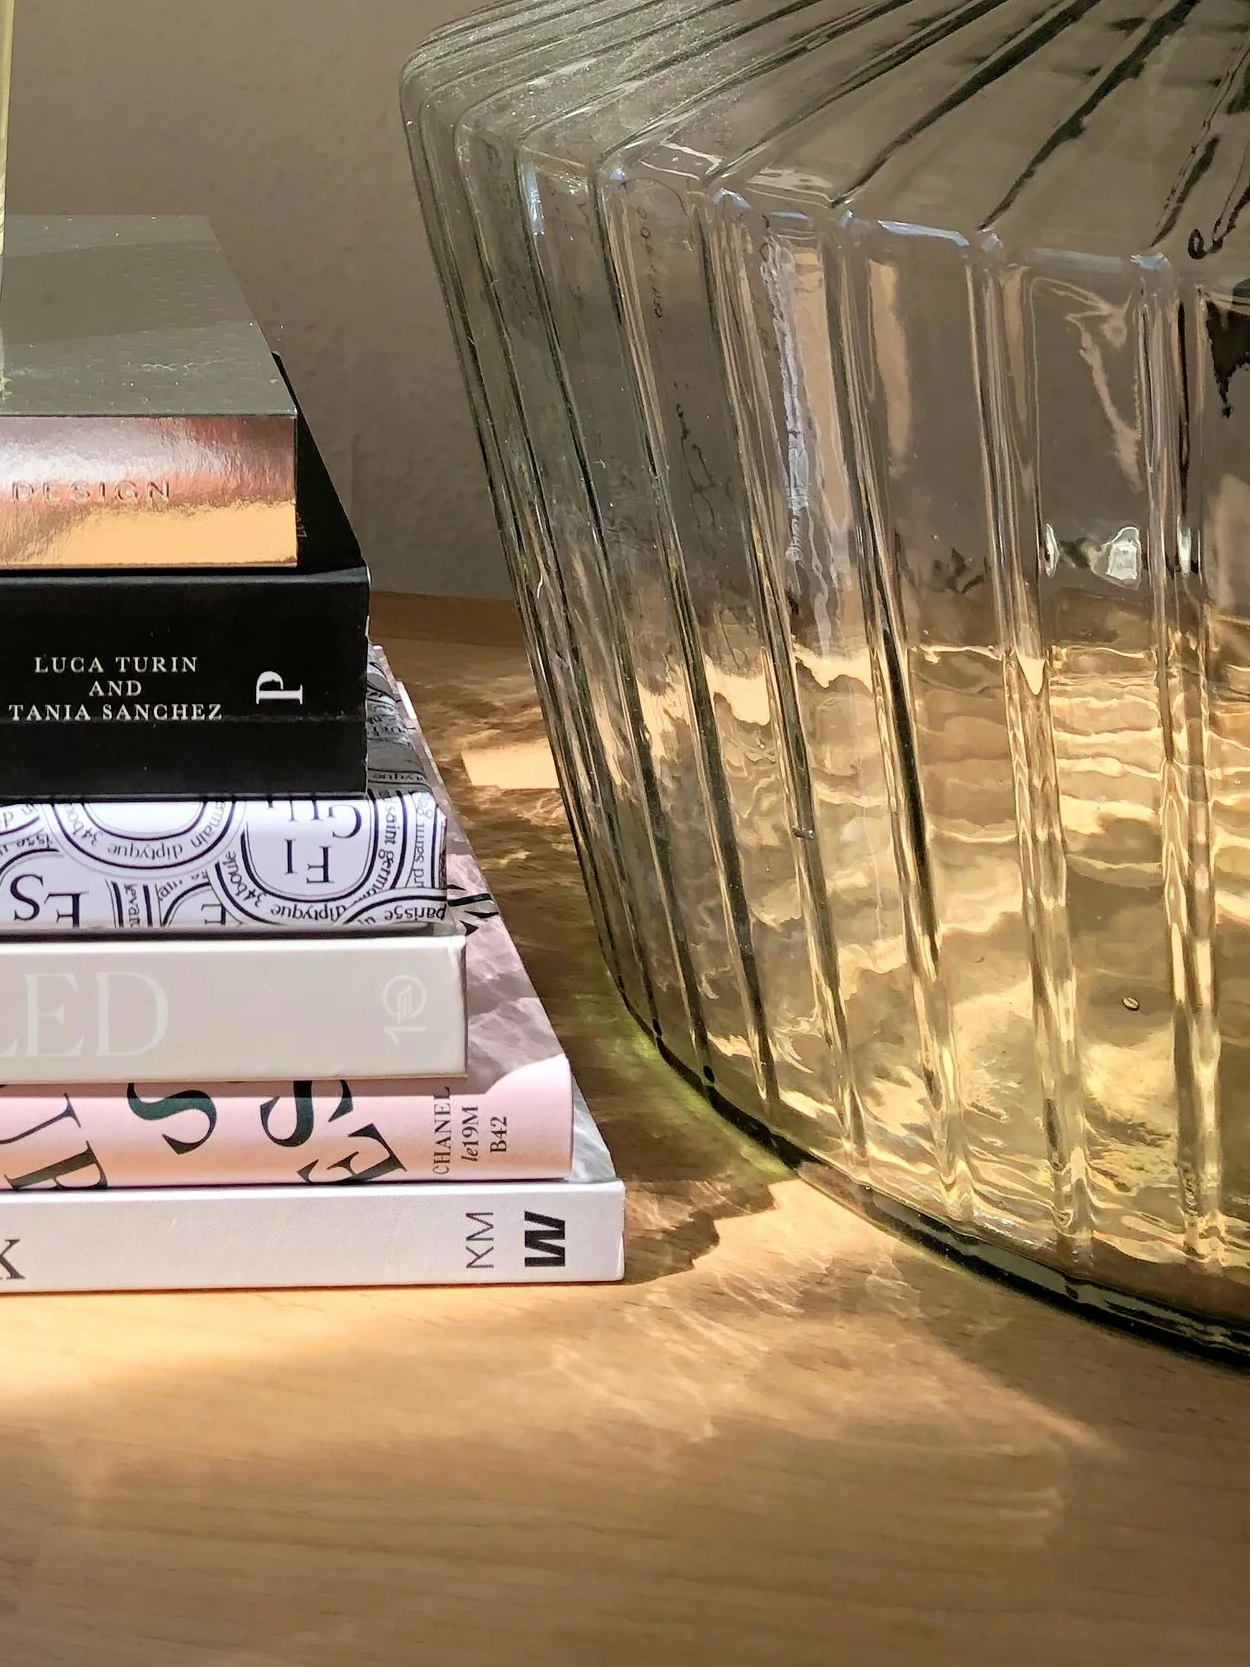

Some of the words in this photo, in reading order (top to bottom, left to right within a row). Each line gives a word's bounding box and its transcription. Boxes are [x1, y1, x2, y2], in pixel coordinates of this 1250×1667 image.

[11, 479, 171, 504] DESIGN
[34, 655, 105, 674] LUCA
[115, 655, 198, 674] TURIN
[88, 679, 143, 698] AND
[256, 670, 304, 706] P
[8, 703, 92, 722] TANIA
[102, 703, 224, 722] SANCHEZ
[107, 842, 184, 862] diptyque
[433, 1085, 450, 1175] CHANEL
[489, 1115, 509, 1154] B42
